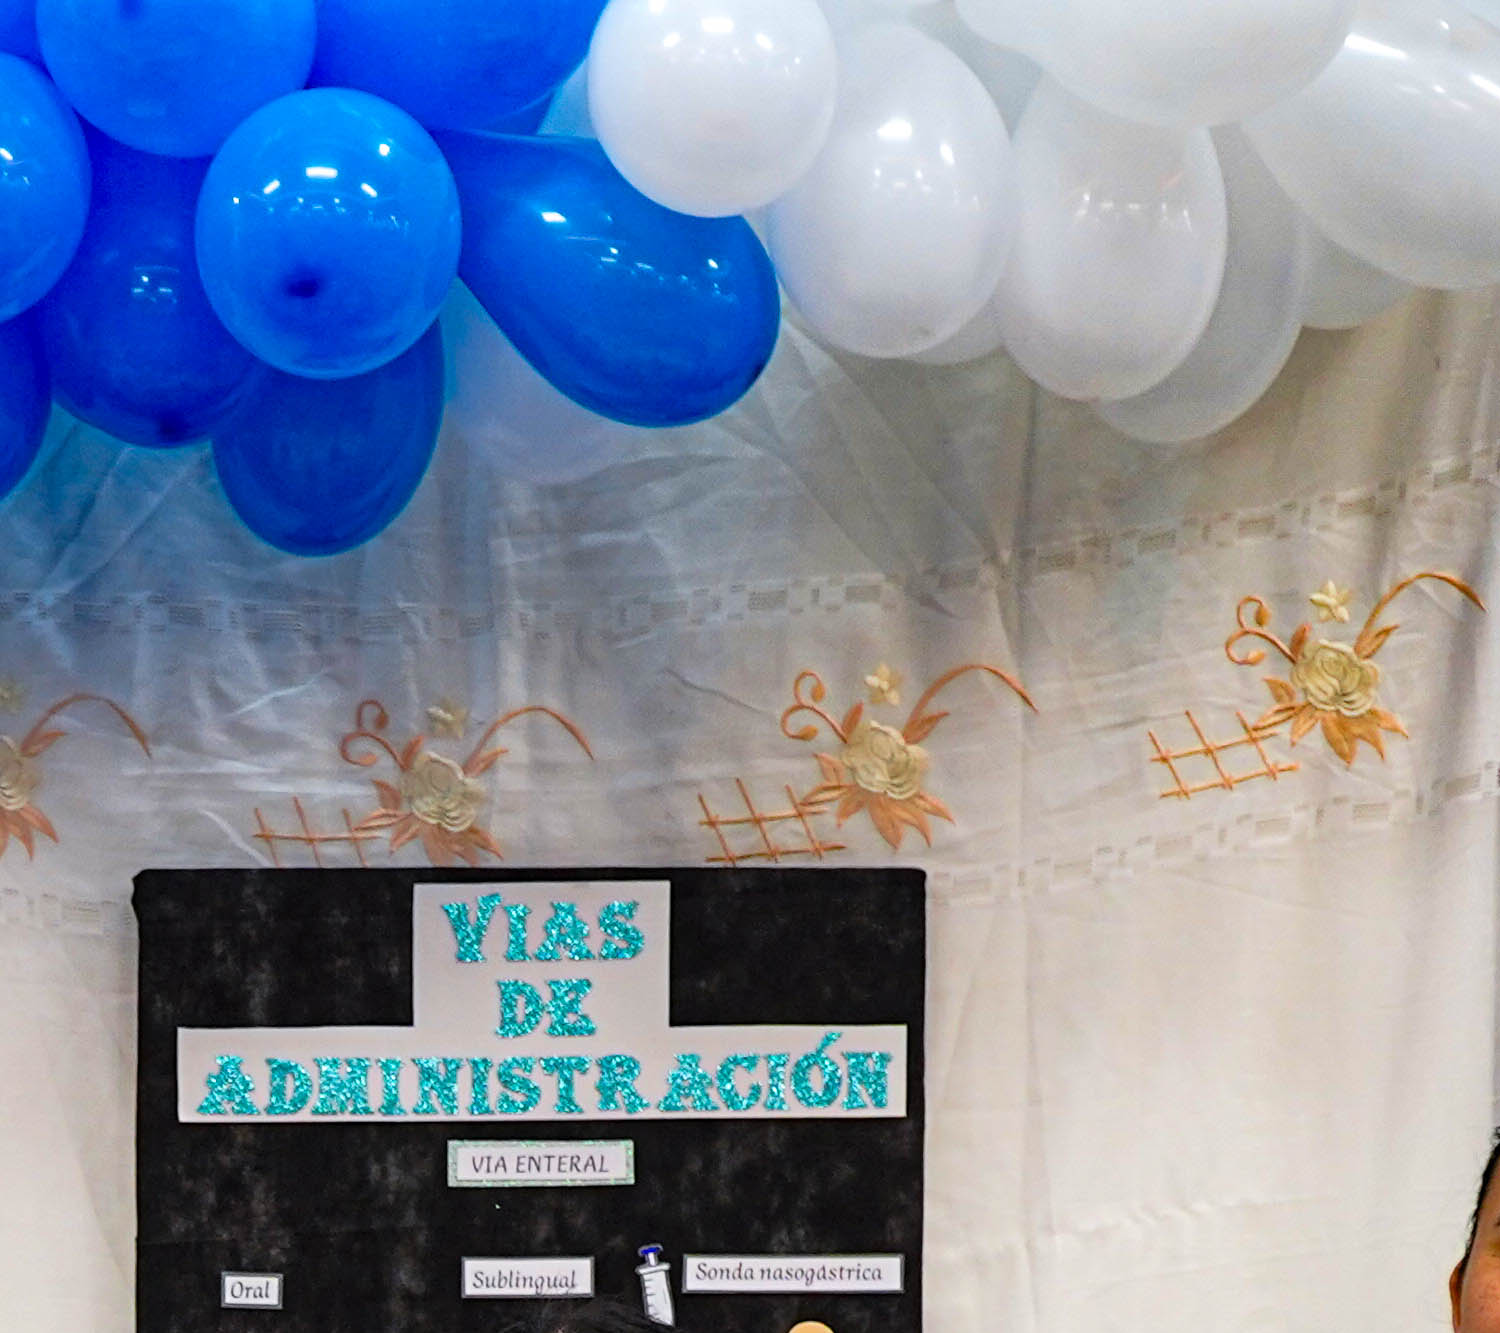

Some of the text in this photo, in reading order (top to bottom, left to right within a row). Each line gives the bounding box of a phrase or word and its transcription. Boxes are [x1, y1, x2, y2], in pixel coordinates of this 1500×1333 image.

[495, 978, 597, 1039] DE
[197, 1031, 893, 1116] ADMINISTRACIÓN
[472, 1154, 609, 1174] VIA ENTERAL
[472, 1269, 579, 1296] Sublingual
[695, 1261, 882, 1287] Sonda nasogástrica
[230, 1281, 270, 1299] Oral
